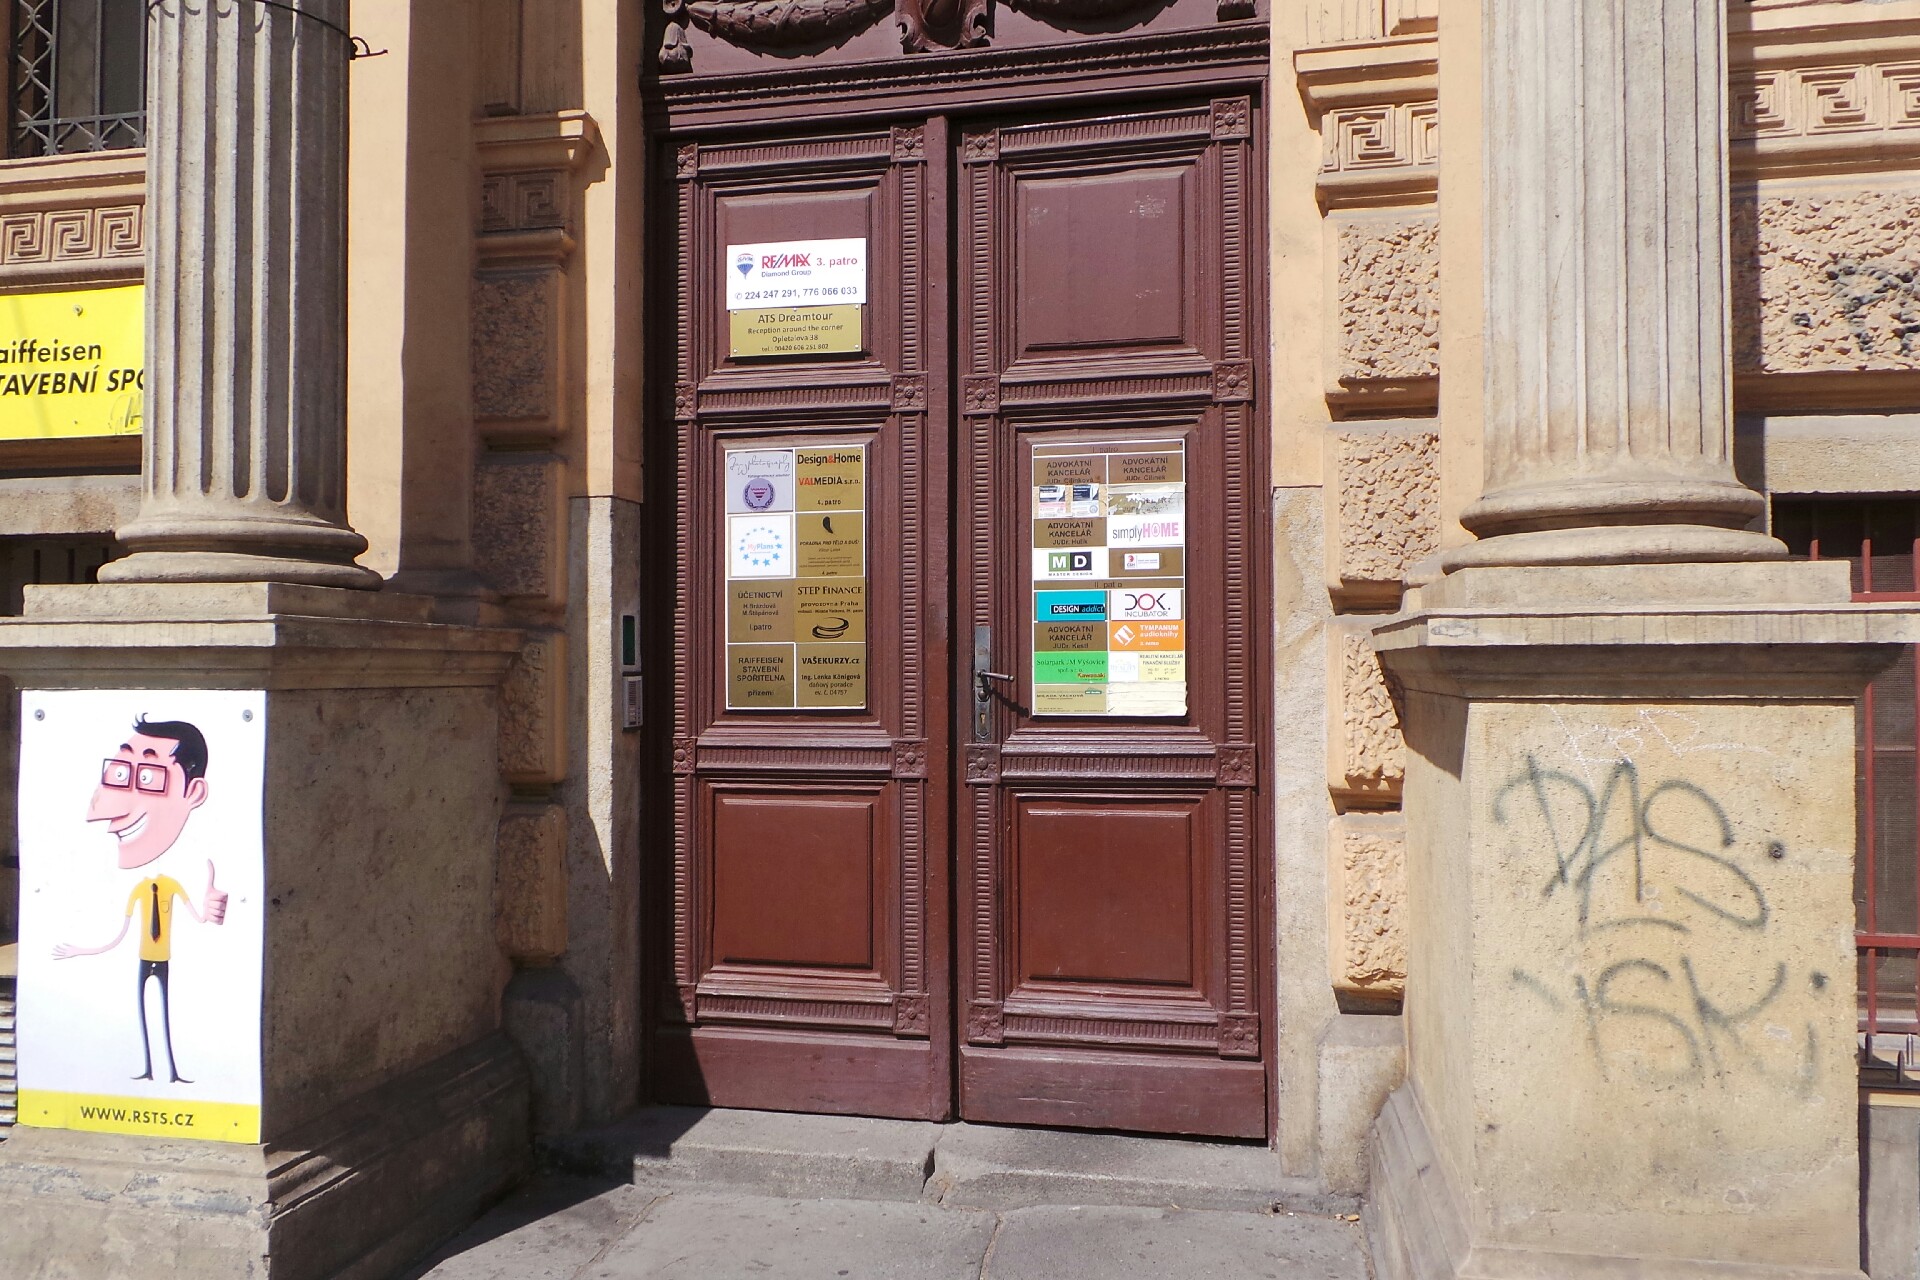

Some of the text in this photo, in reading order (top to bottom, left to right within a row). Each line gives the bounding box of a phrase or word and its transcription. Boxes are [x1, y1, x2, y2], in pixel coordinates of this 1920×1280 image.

[816, 257, 826, 267] 3.
[829, 256, 858, 268] patro
[744, 291, 761, 300] 224
[763, 290, 779, 299] 247
[781, 289, 800, 299] 291,
[803, 287, 819, 297] 776
[841, 286, 858, 295] 033
[757, 312, 833, 324] ATS Dreamtour
[747, 327, 781, 335] Reception
[797, 453, 861, 466] Design&Home
[1047, 459, 1092, 468] ADVOKÁTNÍ
[1122, 456, 1168, 465] ADVOKÁTNÍ
[1047, 468, 1091, 476] KANCELÁŘ
[1123, 465, 1167, 474] KANCELÁŘ
[799, 476, 843, 486] VALMEDIA
[1047, 520, 1093, 529] ADVOKÁTNÍ
[1049, 530, 1092, 538] KANCELÁŘ
[1103, 581, 1122, 590] pato
[797, 586, 820, 595] STEP
[1053, 605, 1104, 613] DESIGN addict
[1125, 610, 1169, 618] INCUBATOR
[1048, 625, 1094, 633] ADVOKÁTNÍ
[1049, 633, 1092, 641] KANCELÁŘ
[1140, 630, 1179, 638] audioknihy
[801, 656, 860, 664] VAŠEKURZY.cz
[742, 665, 780, 673] STAVEBNÍ
[736, 674, 786, 682] SPOŘITELNA
[80, 1105, 195, 1127] WWW.RSTS.CZ
